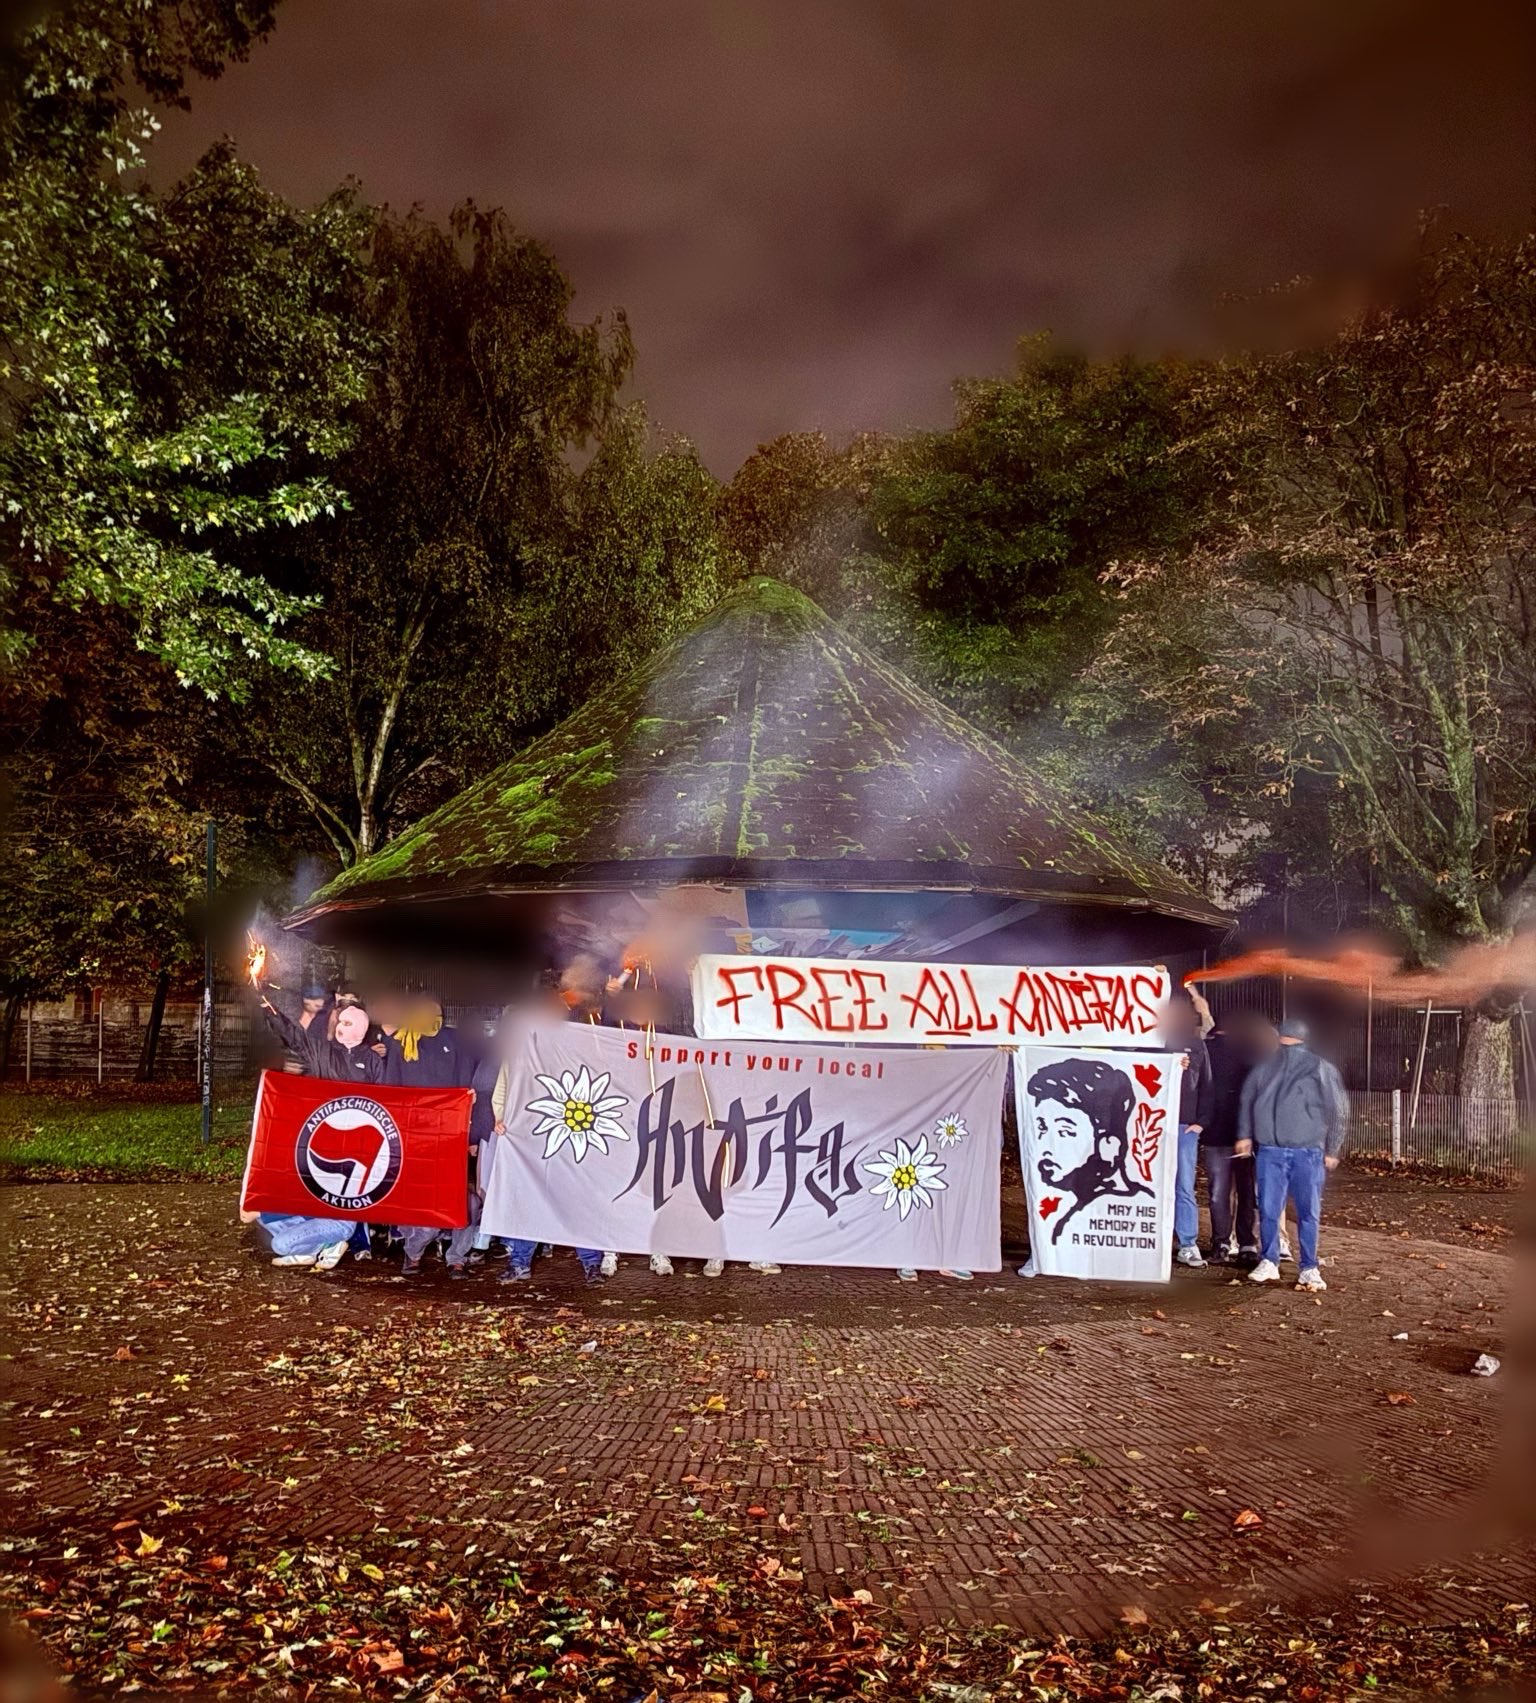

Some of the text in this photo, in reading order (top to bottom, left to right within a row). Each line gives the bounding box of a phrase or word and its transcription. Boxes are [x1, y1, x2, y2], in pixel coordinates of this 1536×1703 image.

[716, 964, 889, 1032] FREE
[901, 967, 997, 1032] ALL
[746, 1054, 803, 1073] your
[818, 1057, 884, 1079] local
[306, 1098, 398, 1140] ANTIFASCHISTISCHE
[321, 1192, 373, 1208] AKTION
[1107, 1204, 1157, 1218] MAY HIS
[1089, 1218, 1156, 1233] MEMORY BE
[1072, 1233, 1156, 1249] A REVOLUTION
